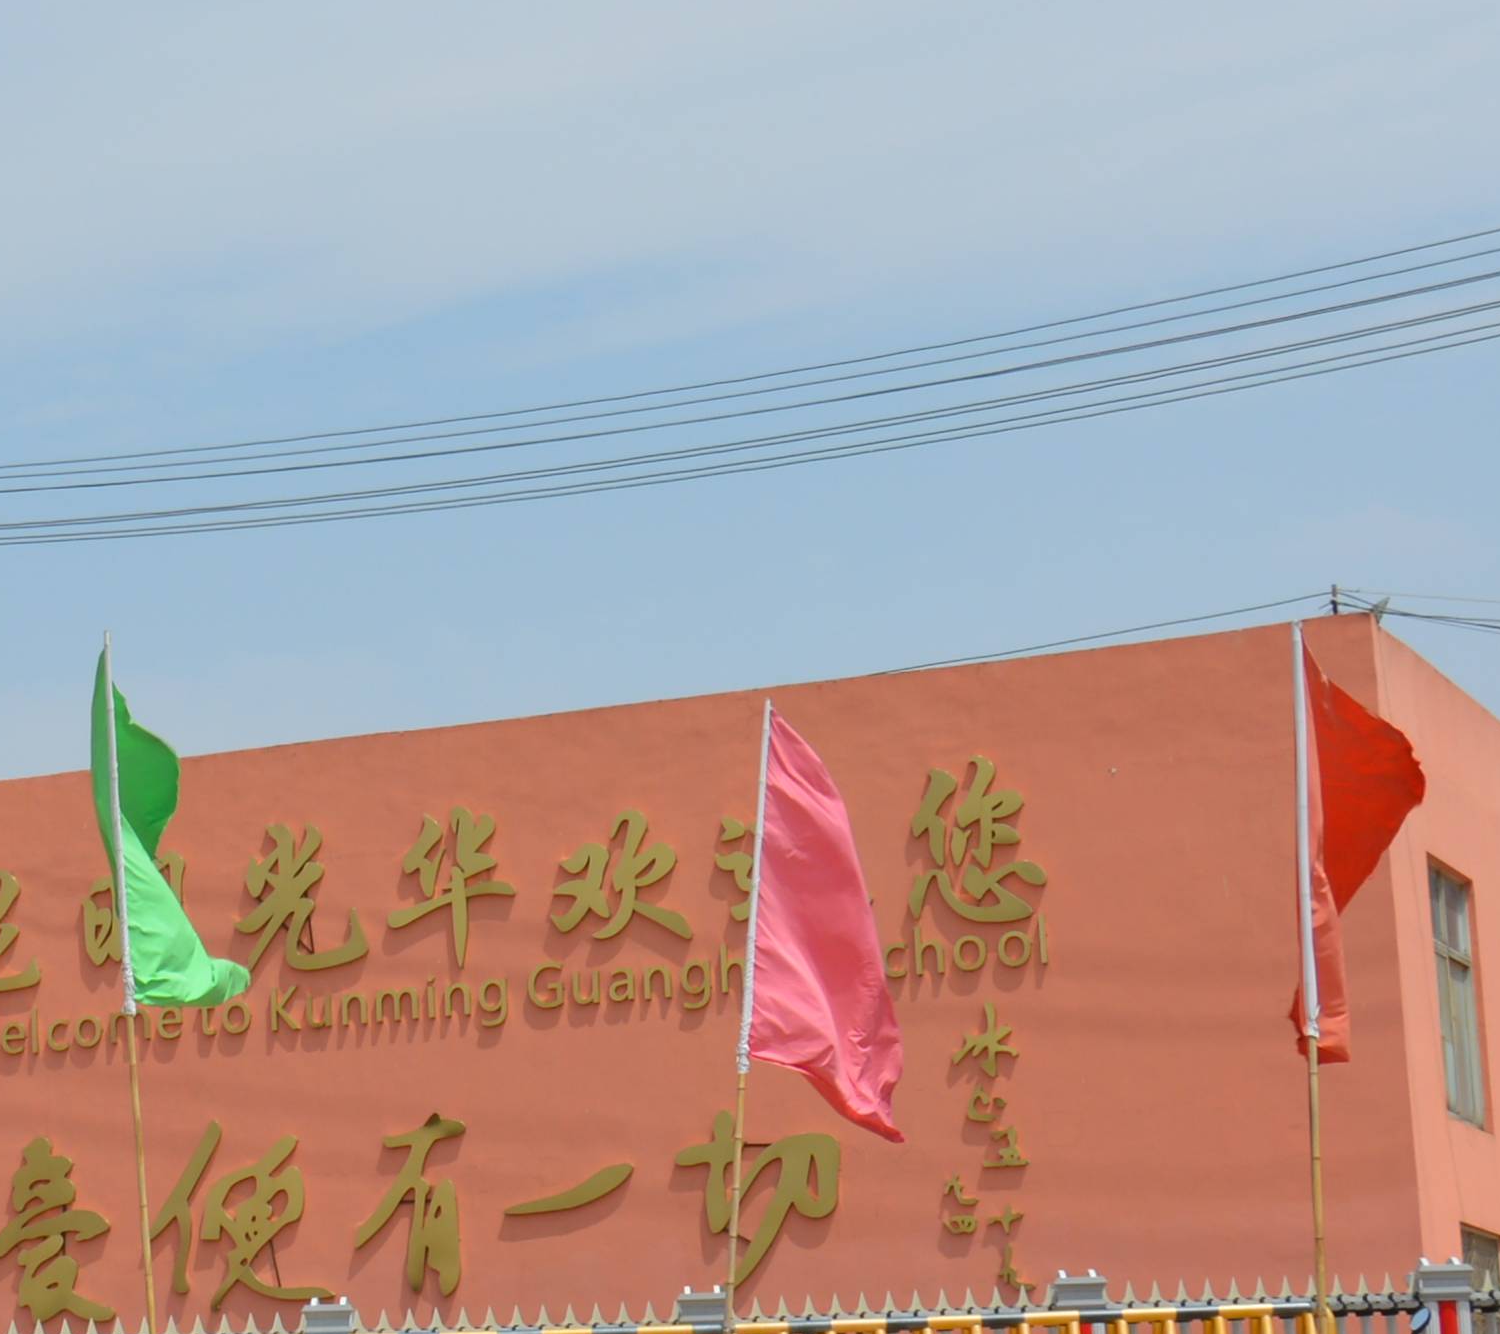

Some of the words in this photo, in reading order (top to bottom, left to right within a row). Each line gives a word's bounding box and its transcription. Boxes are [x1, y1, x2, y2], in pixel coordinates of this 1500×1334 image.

[200, 1000, 252, 1036] to
[268, 976, 509, 1032] Kunming
[527, 940, 749, 1010] Guangh
[883, 912, 1049, 979] chool
